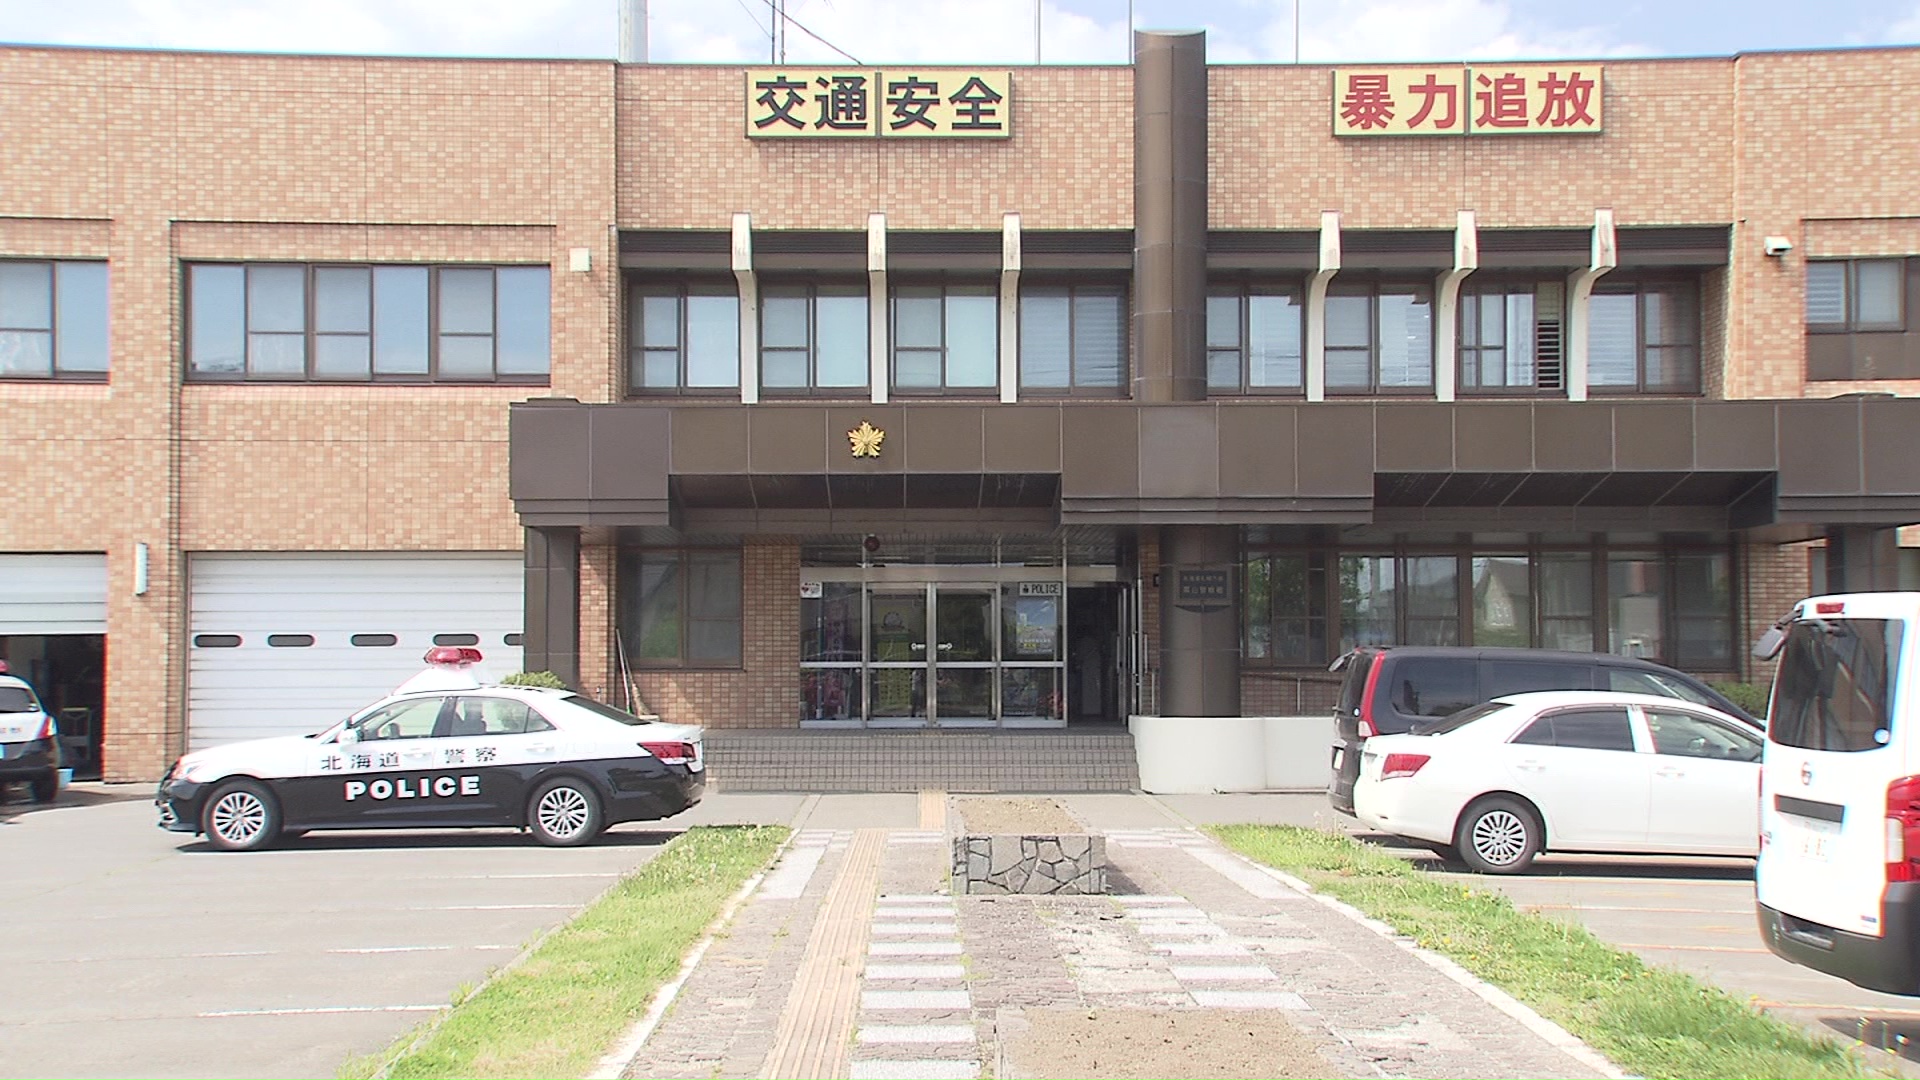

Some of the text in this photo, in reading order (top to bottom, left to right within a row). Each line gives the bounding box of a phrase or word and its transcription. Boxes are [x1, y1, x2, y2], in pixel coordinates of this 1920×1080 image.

[754, 76, 1003, 130] 交通安全
[1340, 72, 1594, 129] 暴力追放
[1031, 584, 1059, 594] POLICE
[321, 746, 497, 770] 北海道 警察
[344, 776, 481, 801] POLICE
